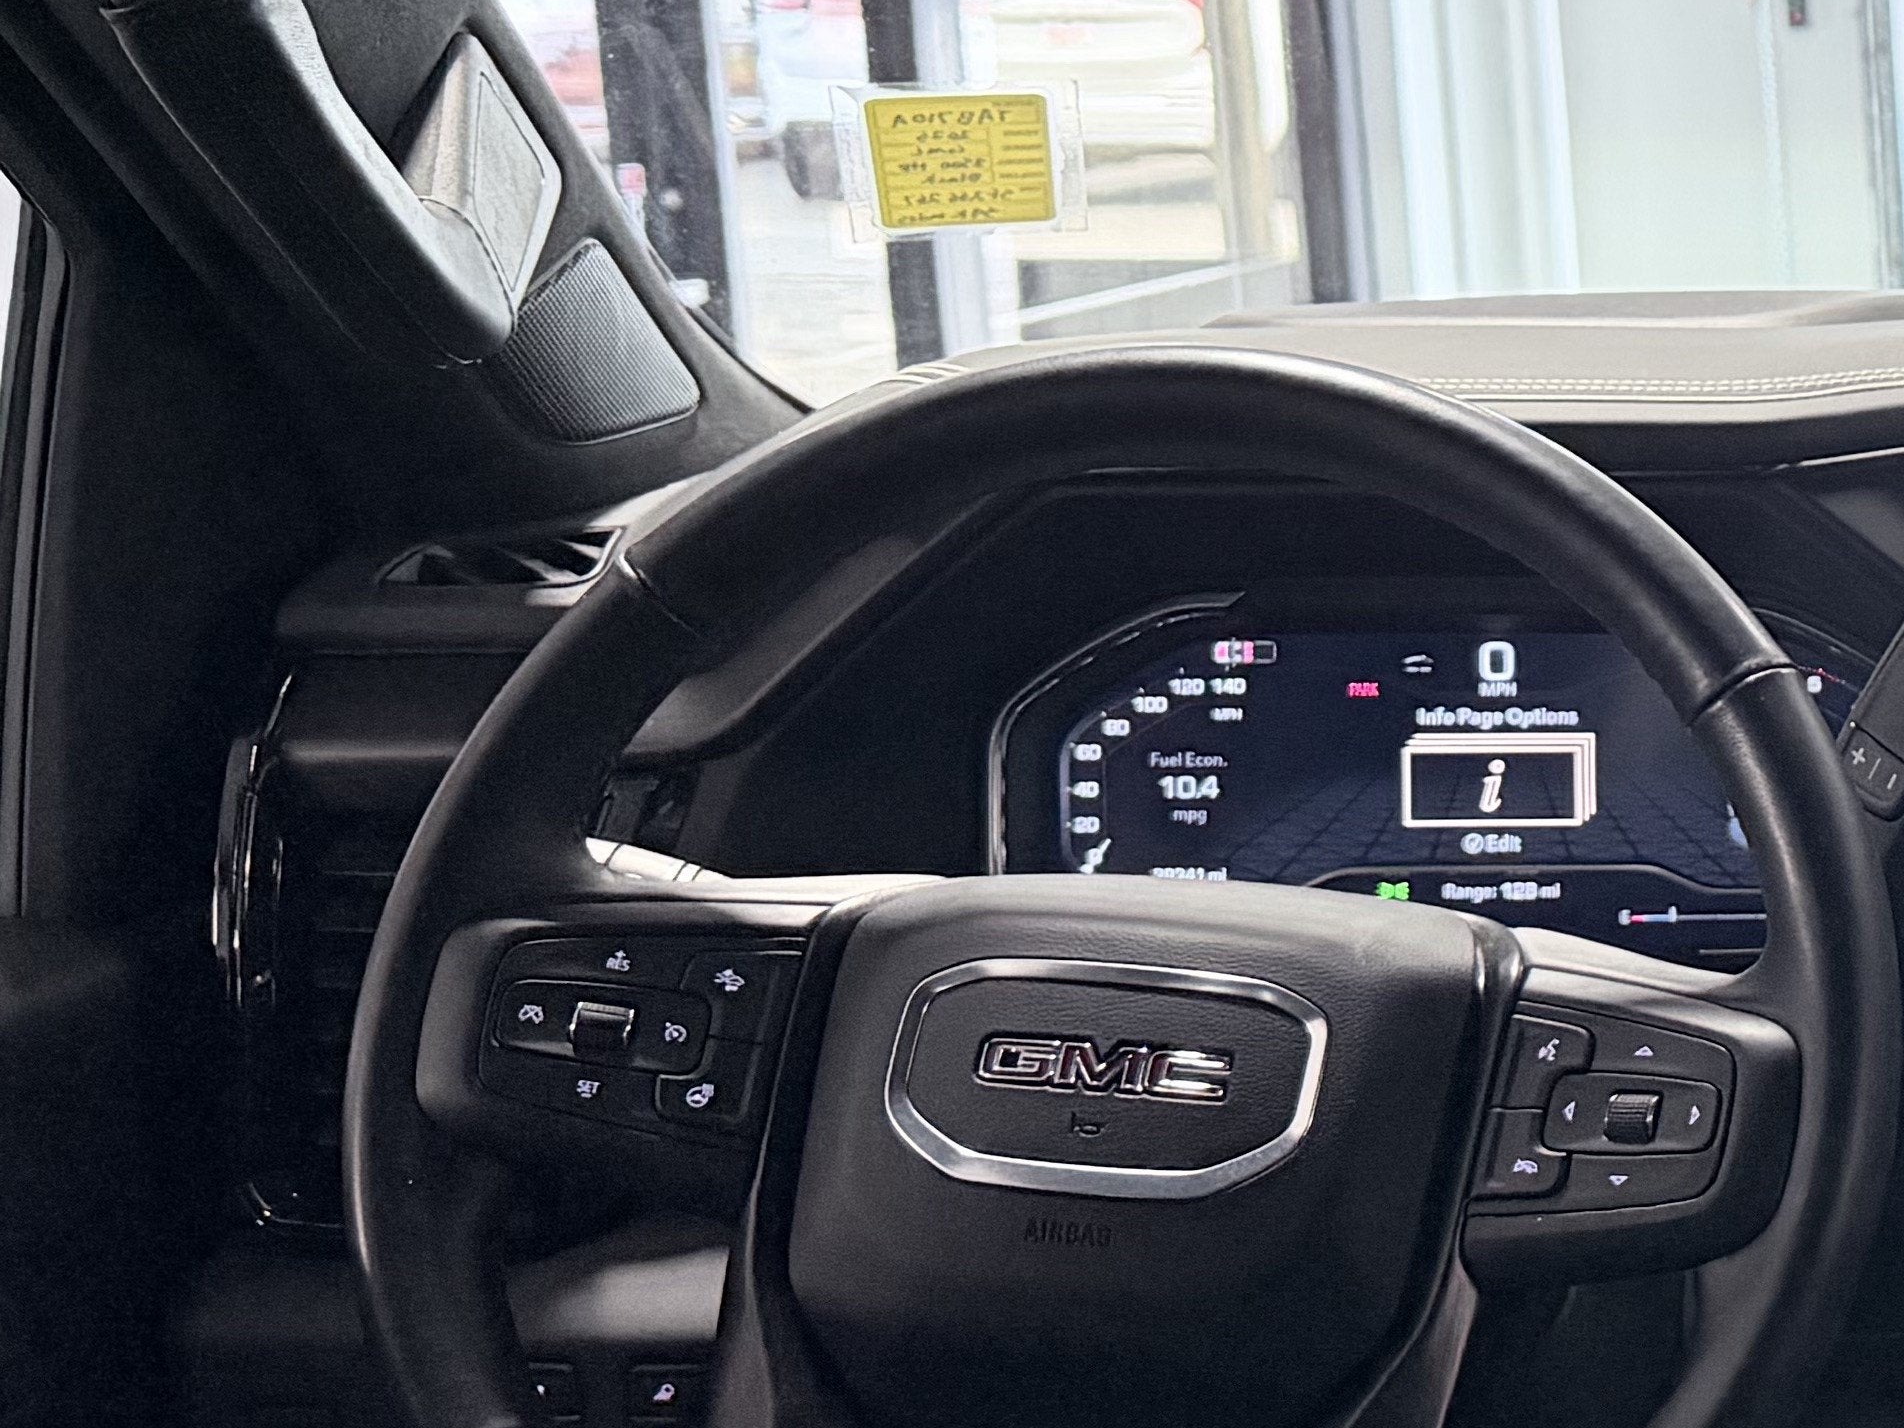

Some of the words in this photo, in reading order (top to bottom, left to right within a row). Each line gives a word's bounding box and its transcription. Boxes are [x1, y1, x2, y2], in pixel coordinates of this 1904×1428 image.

[1478, 640, 1516, 682] 0
[1211, 677, 1247, 695] 140
[1477, 681, 1518, 697] MPH
[1131, 696, 1169, 714] 100
[1415, 707, 1455, 726] Info
[1456, 707, 1503, 730] Page
[1504, 707, 1580, 729] Options
[1150, 752, 1182, 768] Fuel
[1185, 752, 1229, 768] Econ.
[1158, 775, 1221, 800] 10.4
[1172, 809, 1208, 826] mpg
[1483, 833, 1523, 853] Edit
[1441, 882, 1497, 904] Range:
[975, 1035, 1234, 1105] GMC
